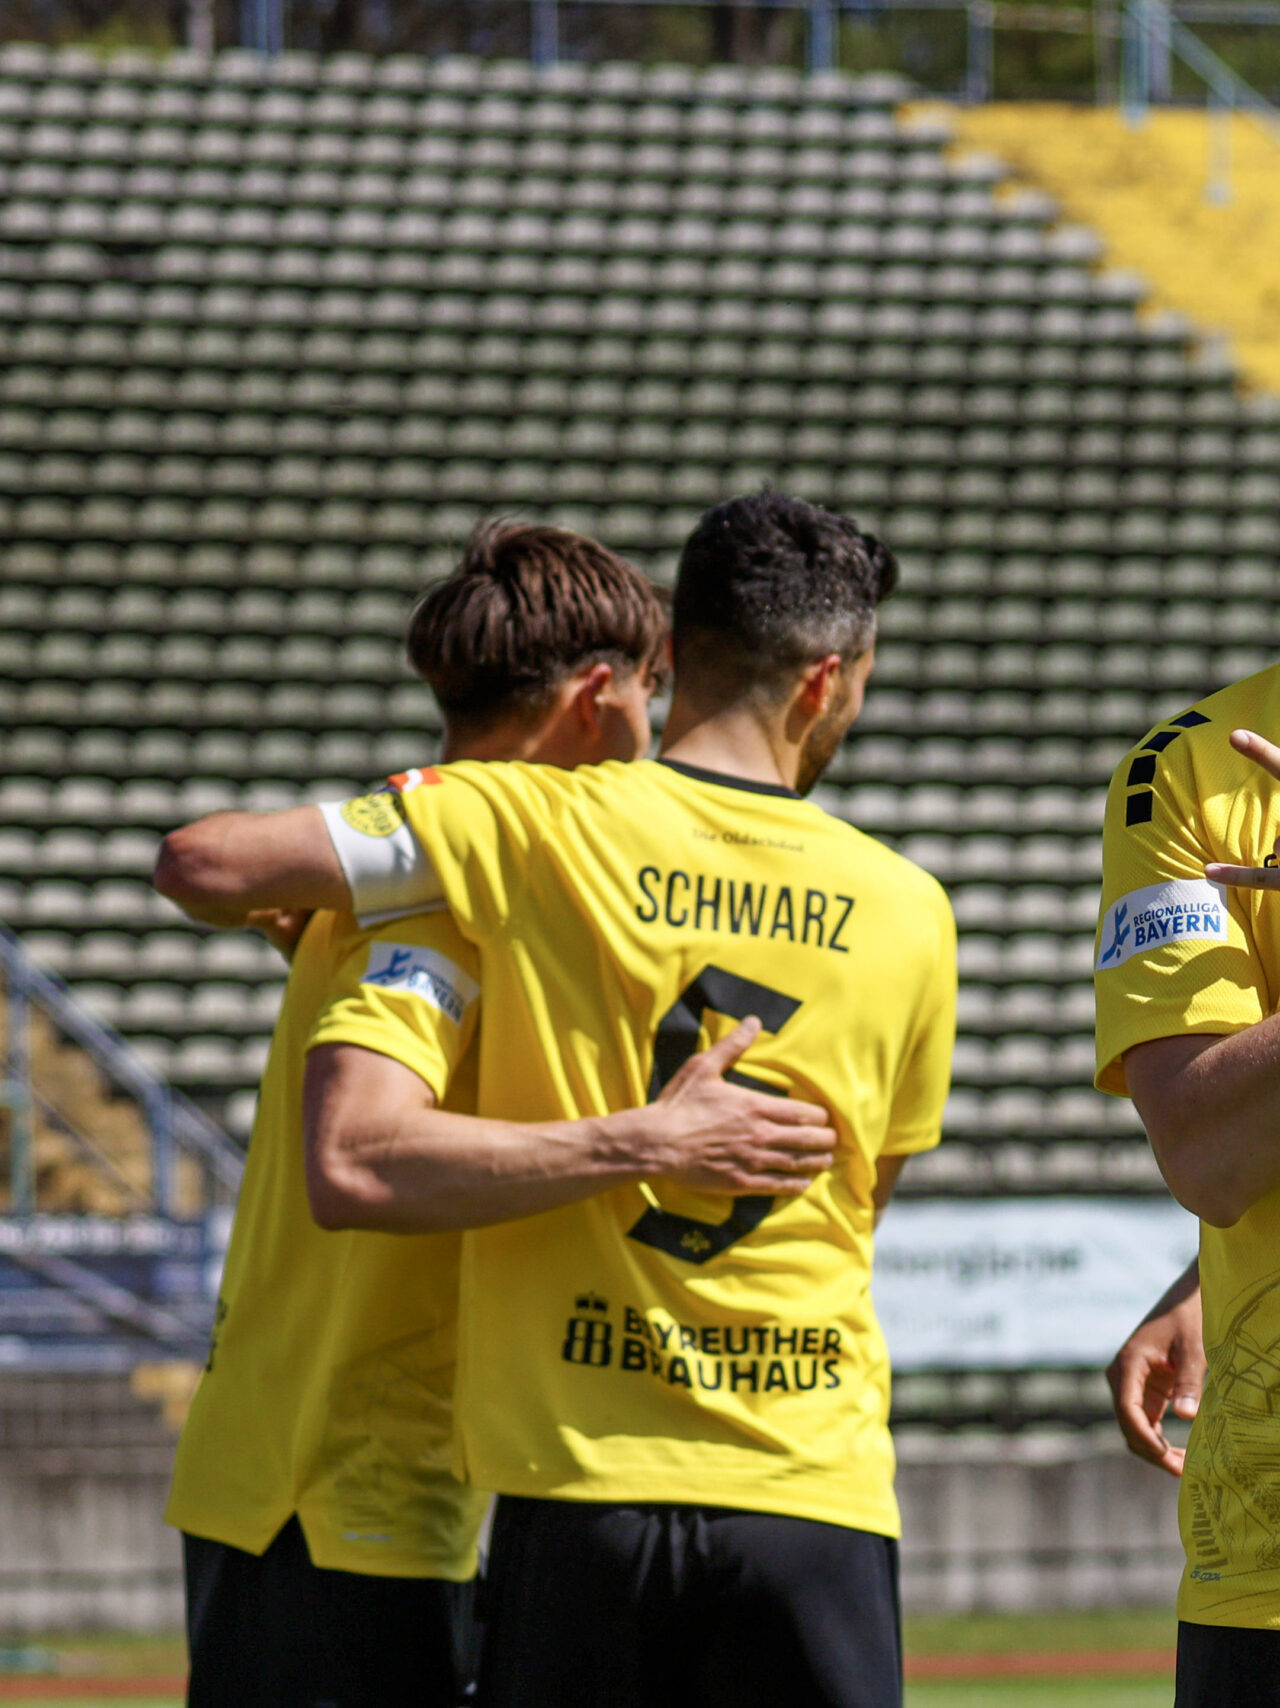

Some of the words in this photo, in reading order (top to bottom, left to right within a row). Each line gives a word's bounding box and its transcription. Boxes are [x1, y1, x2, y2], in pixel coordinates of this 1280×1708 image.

[635, 866, 857, 954] SCHWARZ
[1133, 903, 1220, 927] REGIONALLIGA
[1134, 914, 1221, 947] BAYERN
